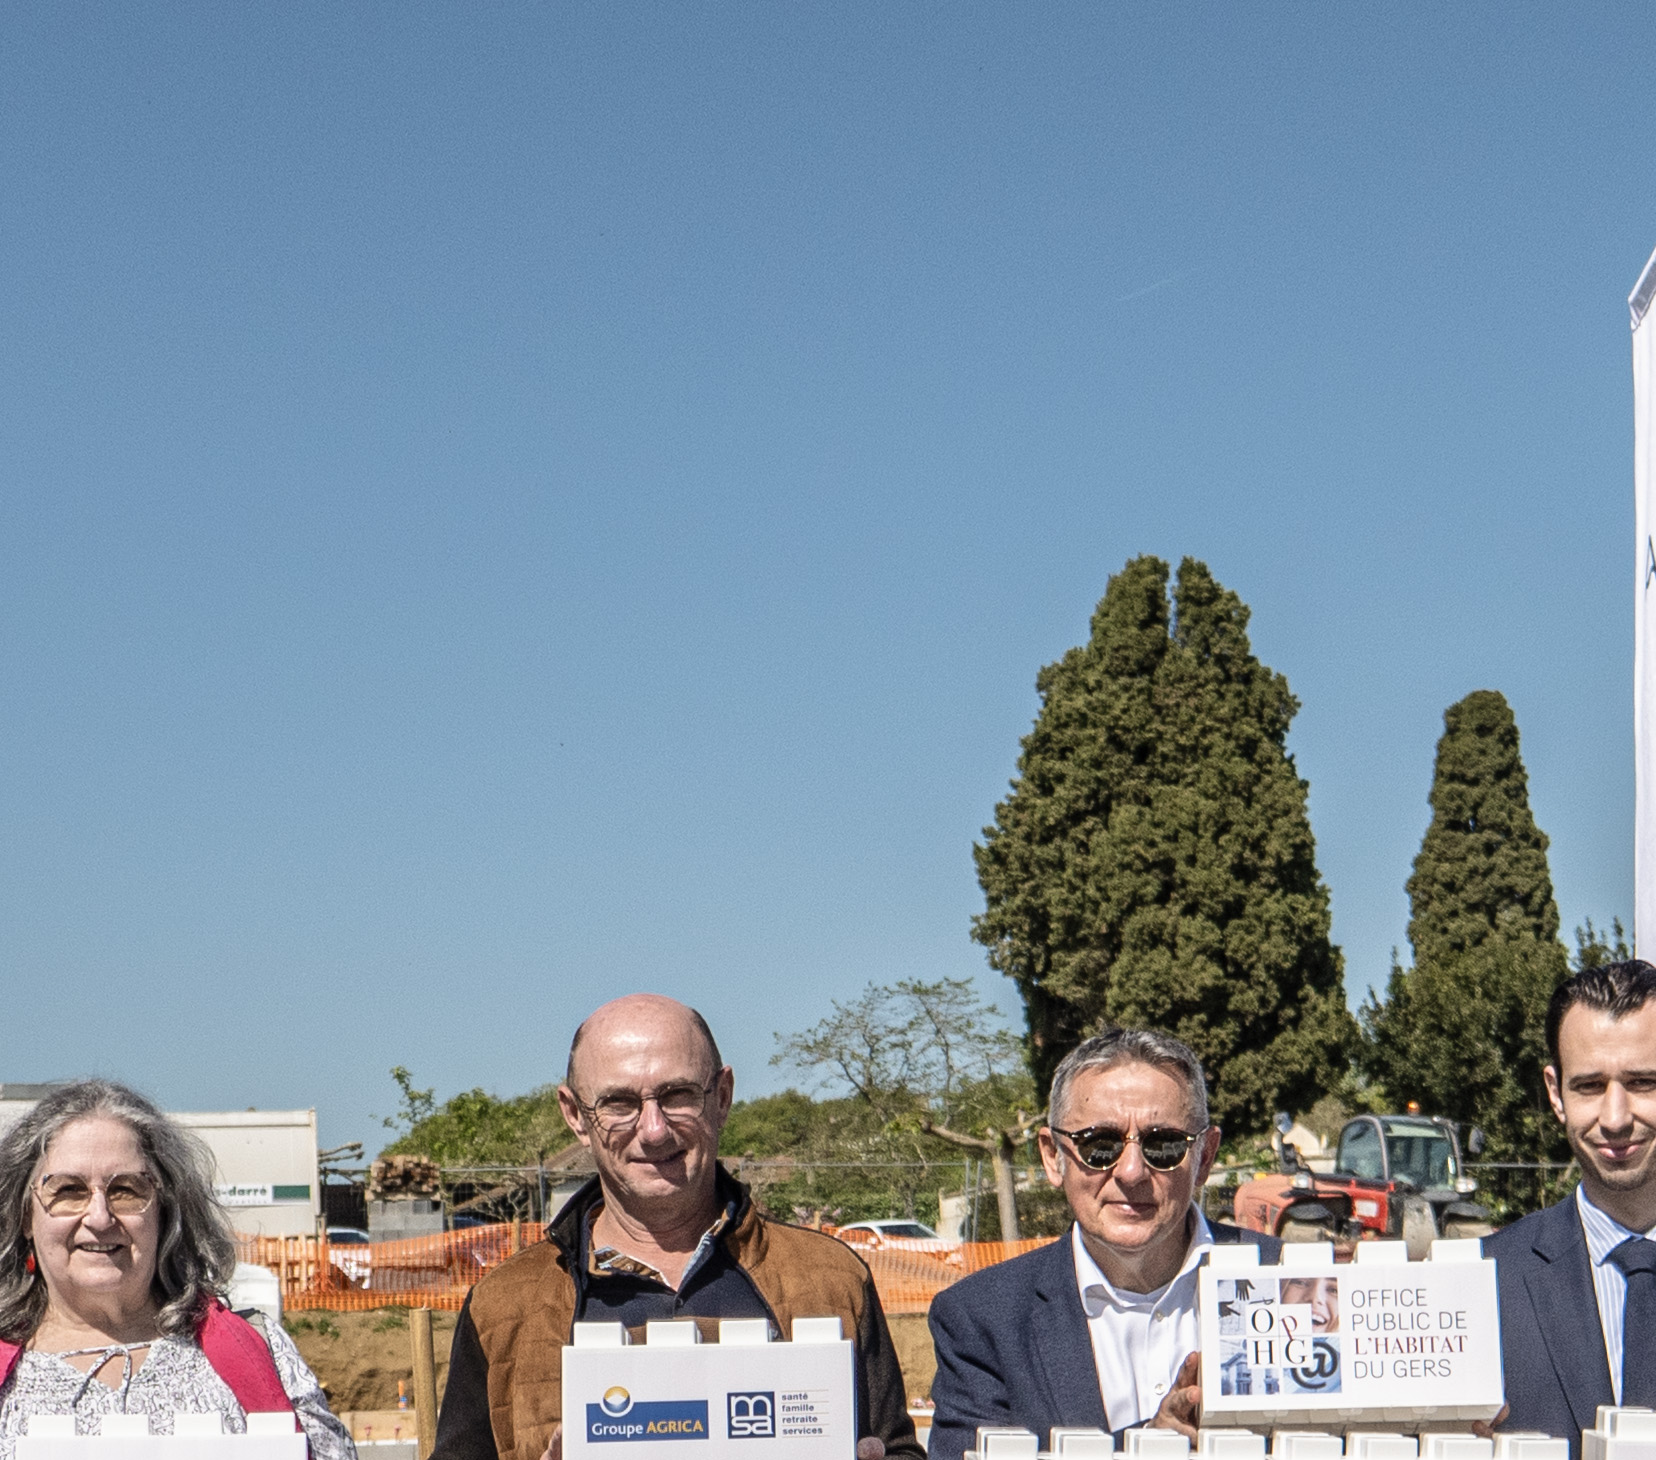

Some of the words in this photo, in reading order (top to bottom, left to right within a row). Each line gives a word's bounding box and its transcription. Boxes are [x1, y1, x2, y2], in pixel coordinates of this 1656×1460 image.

[1351, 1288, 1427, 1308] OFFICE
[1352, 1312, 1430, 1331] PUBLIC
[1439, 1311, 1467, 1329] DE
[1354, 1335, 1468, 1355] L'HABITAT
[1354, 1360, 1384, 1379] DU
[1393, 1359, 1451, 1378] GERS
[781, 1391, 808, 1401] santé
[782, 1404, 814, 1412] famille
[782, 1415, 818, 1423] retraite
[592, 1422, 643, 1438] Groupe
[646, 1420, 704, 1434] AGRICA
[783, 1426, 823, 1435] services
